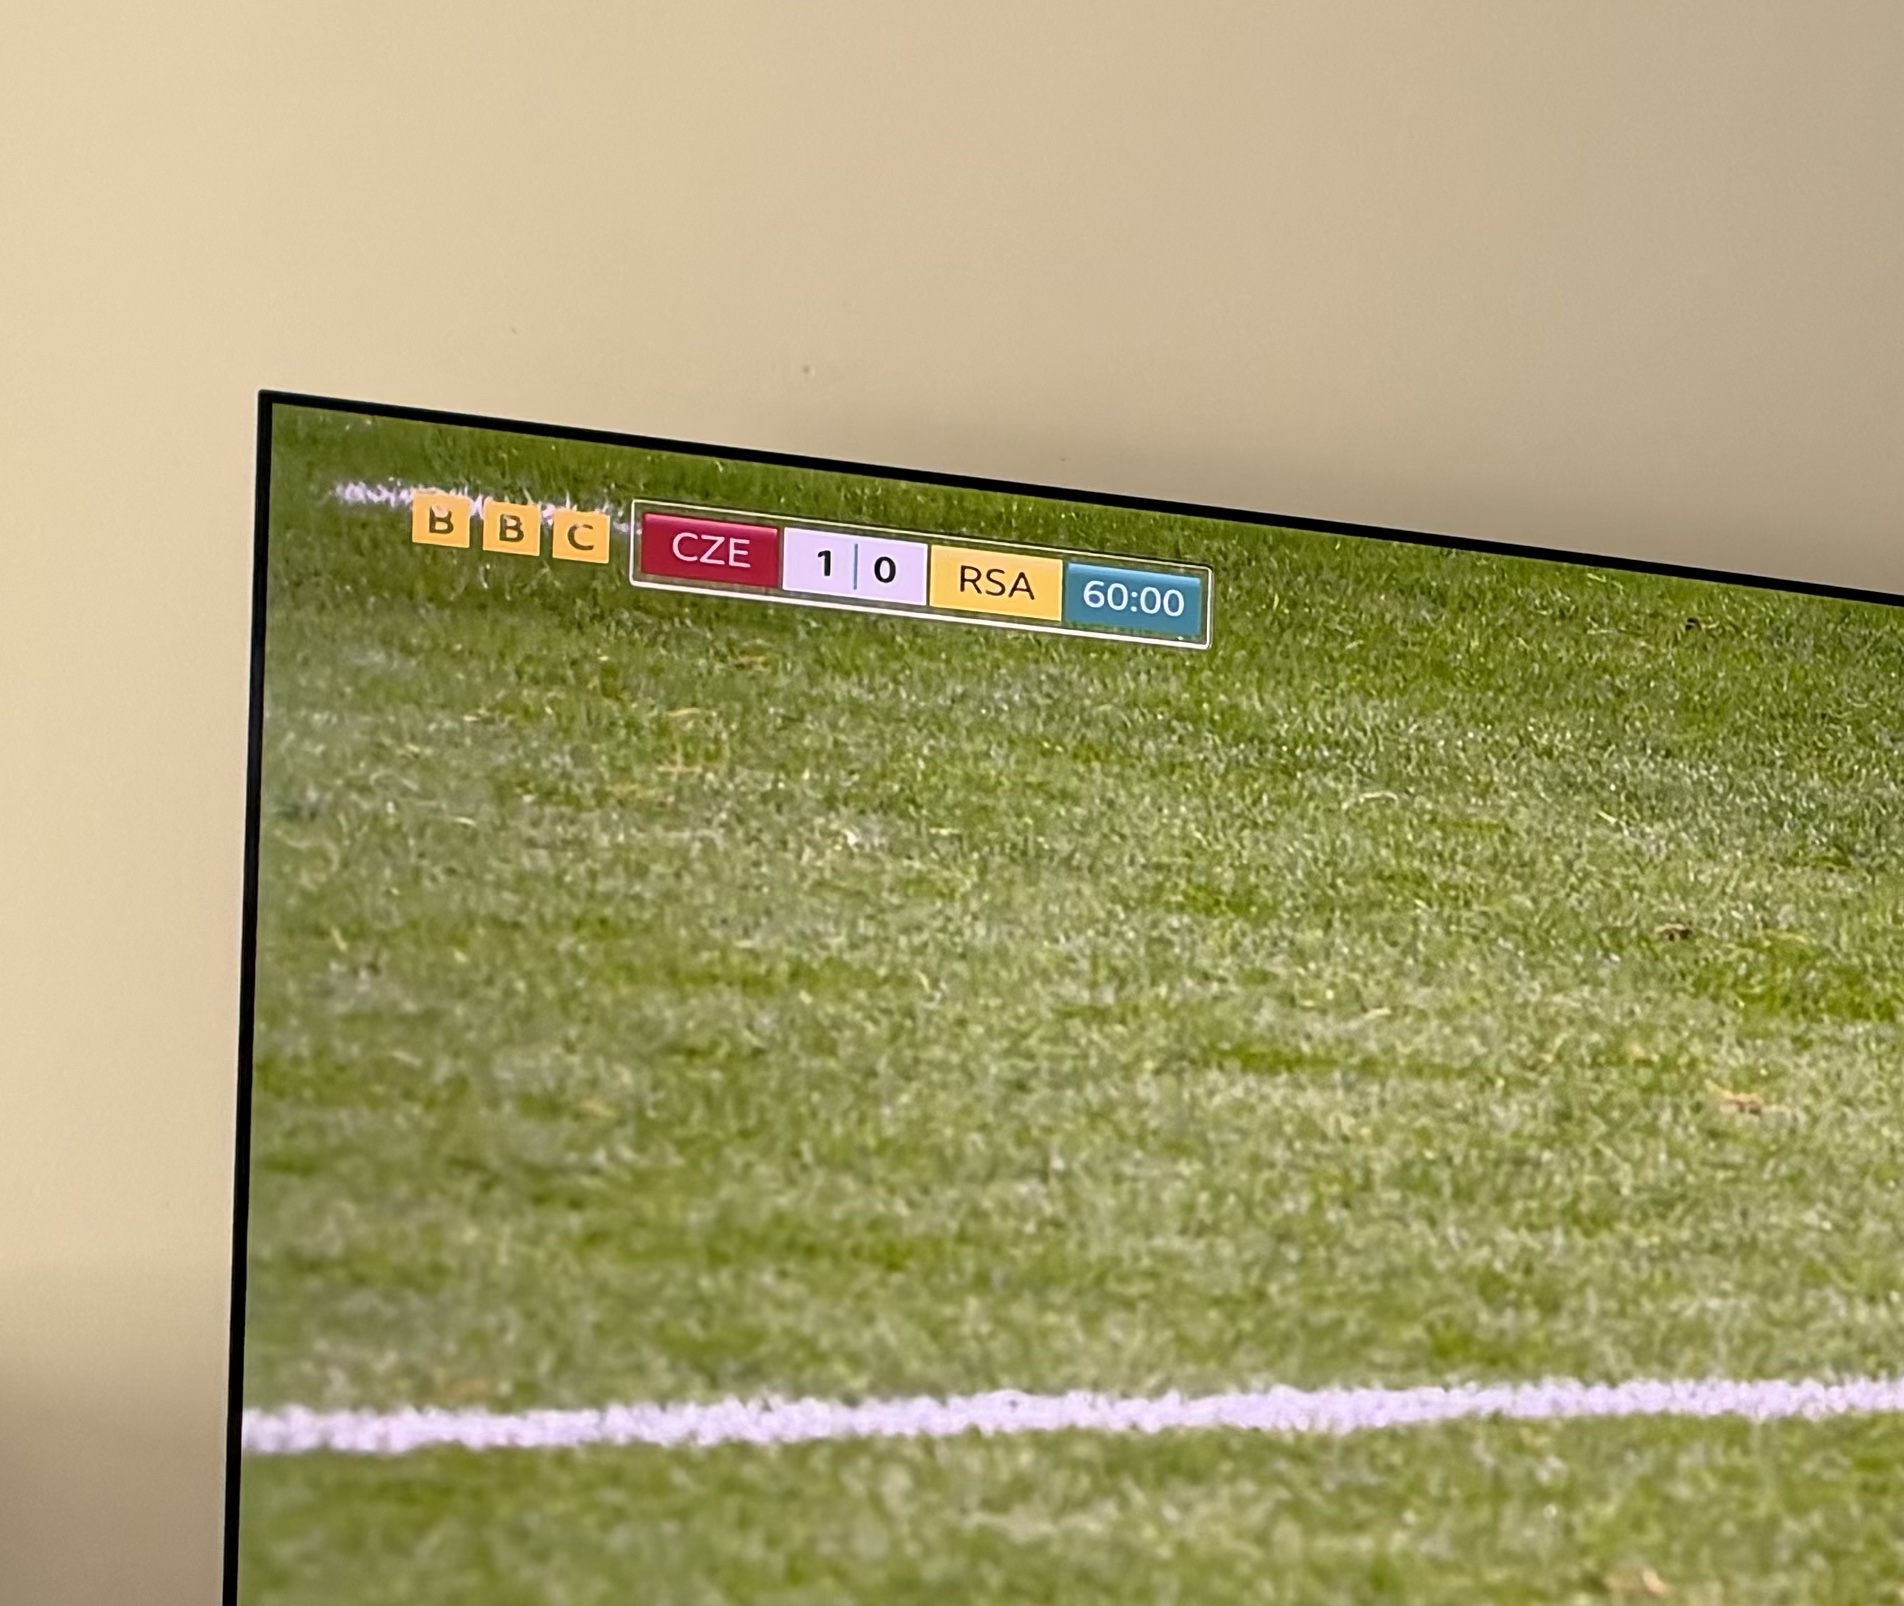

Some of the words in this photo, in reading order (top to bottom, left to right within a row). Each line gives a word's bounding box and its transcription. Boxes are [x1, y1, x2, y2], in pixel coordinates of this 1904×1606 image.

[672, 531, 751, 569] CZE
[817, 550, 832, 577] 1
[873, 556, 897, 584] 0
[959, 565, 1036, 601] RSA
[1082, 580, 1185, 618] 60:00
